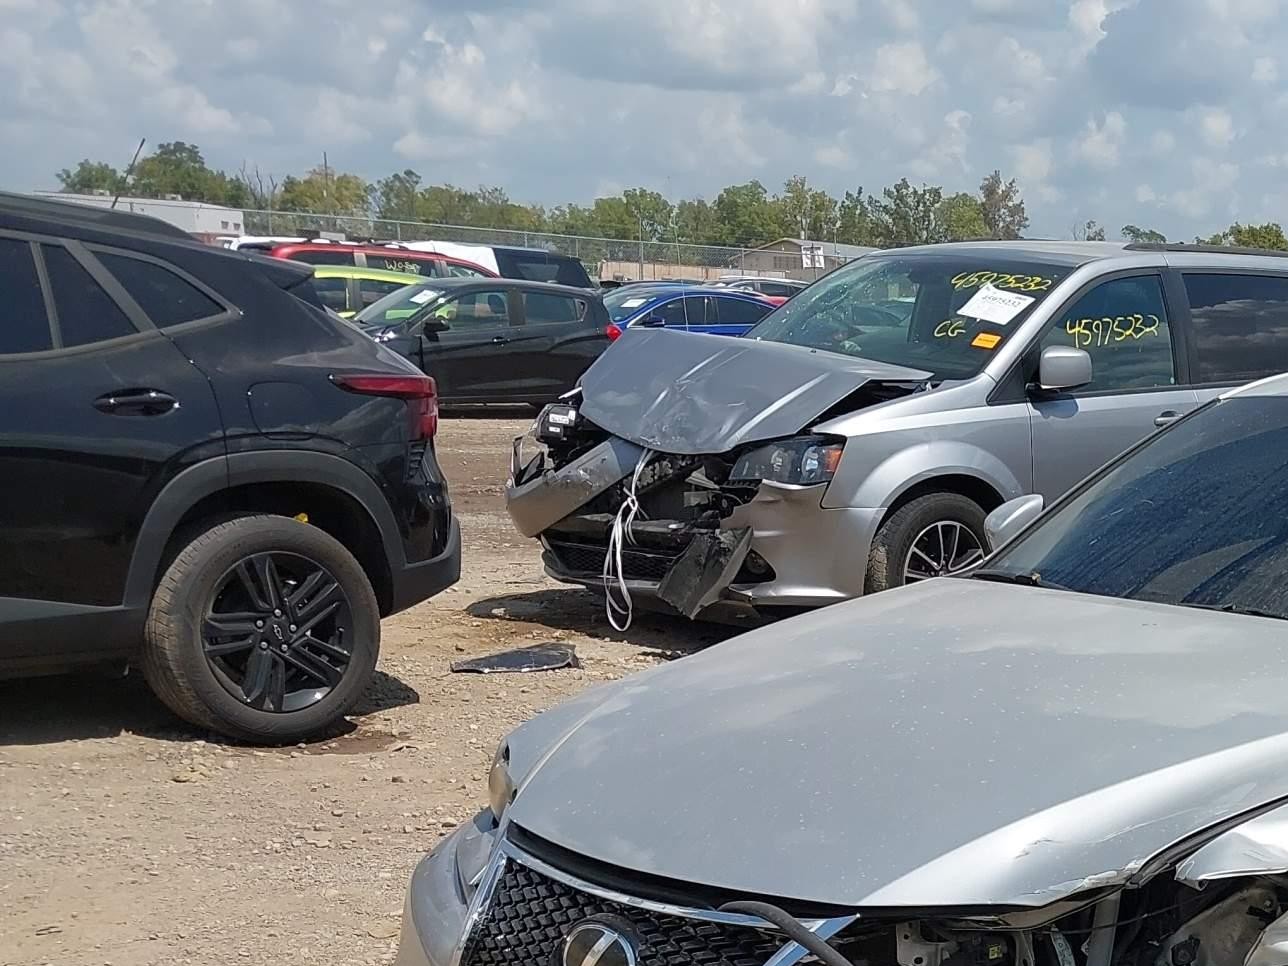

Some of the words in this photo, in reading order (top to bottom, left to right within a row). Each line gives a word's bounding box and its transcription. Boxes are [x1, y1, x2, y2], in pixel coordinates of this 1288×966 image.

[951, 271, 1052, 291] 45975232
[934, 320, 966, 337] CG
[1066, 313, 1159, 349] 45975232
